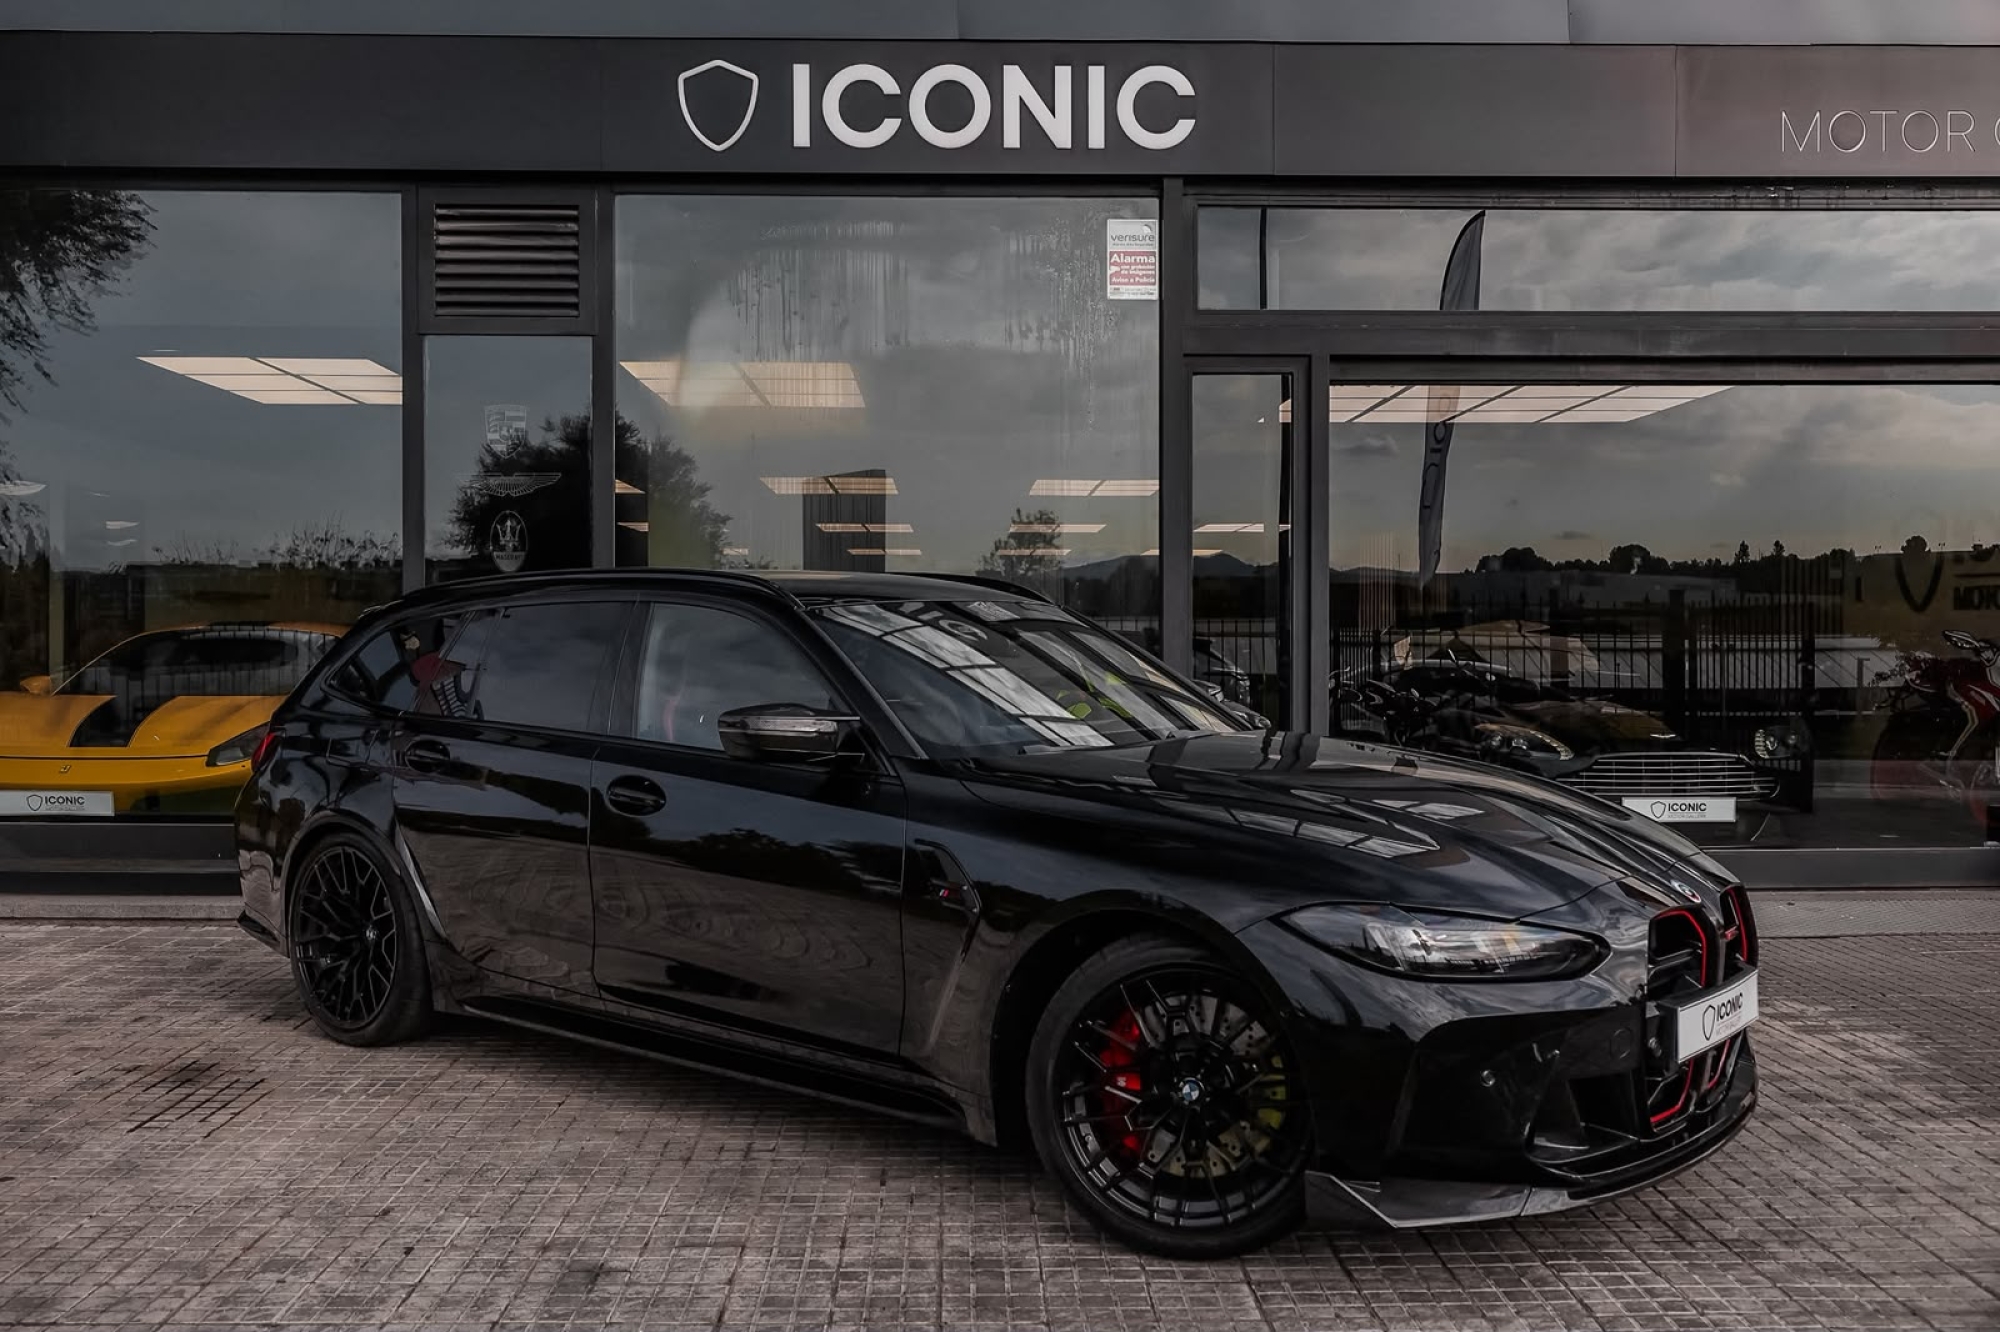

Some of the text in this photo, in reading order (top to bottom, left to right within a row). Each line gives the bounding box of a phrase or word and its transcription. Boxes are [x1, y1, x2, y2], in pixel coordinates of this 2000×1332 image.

[793, 63, 1197, 150] ICONIC
[1781, 109, 1976, 153] MOTOR
[1110, 233, 1155, 242] verisure
[1110, 253, 1155, 263] Alarma
[45, 795, 85, 806] ICONIC
[1668, 803, 1707, 812] ICONIC
[1716, 992, 1743, 1022] ICONIC
